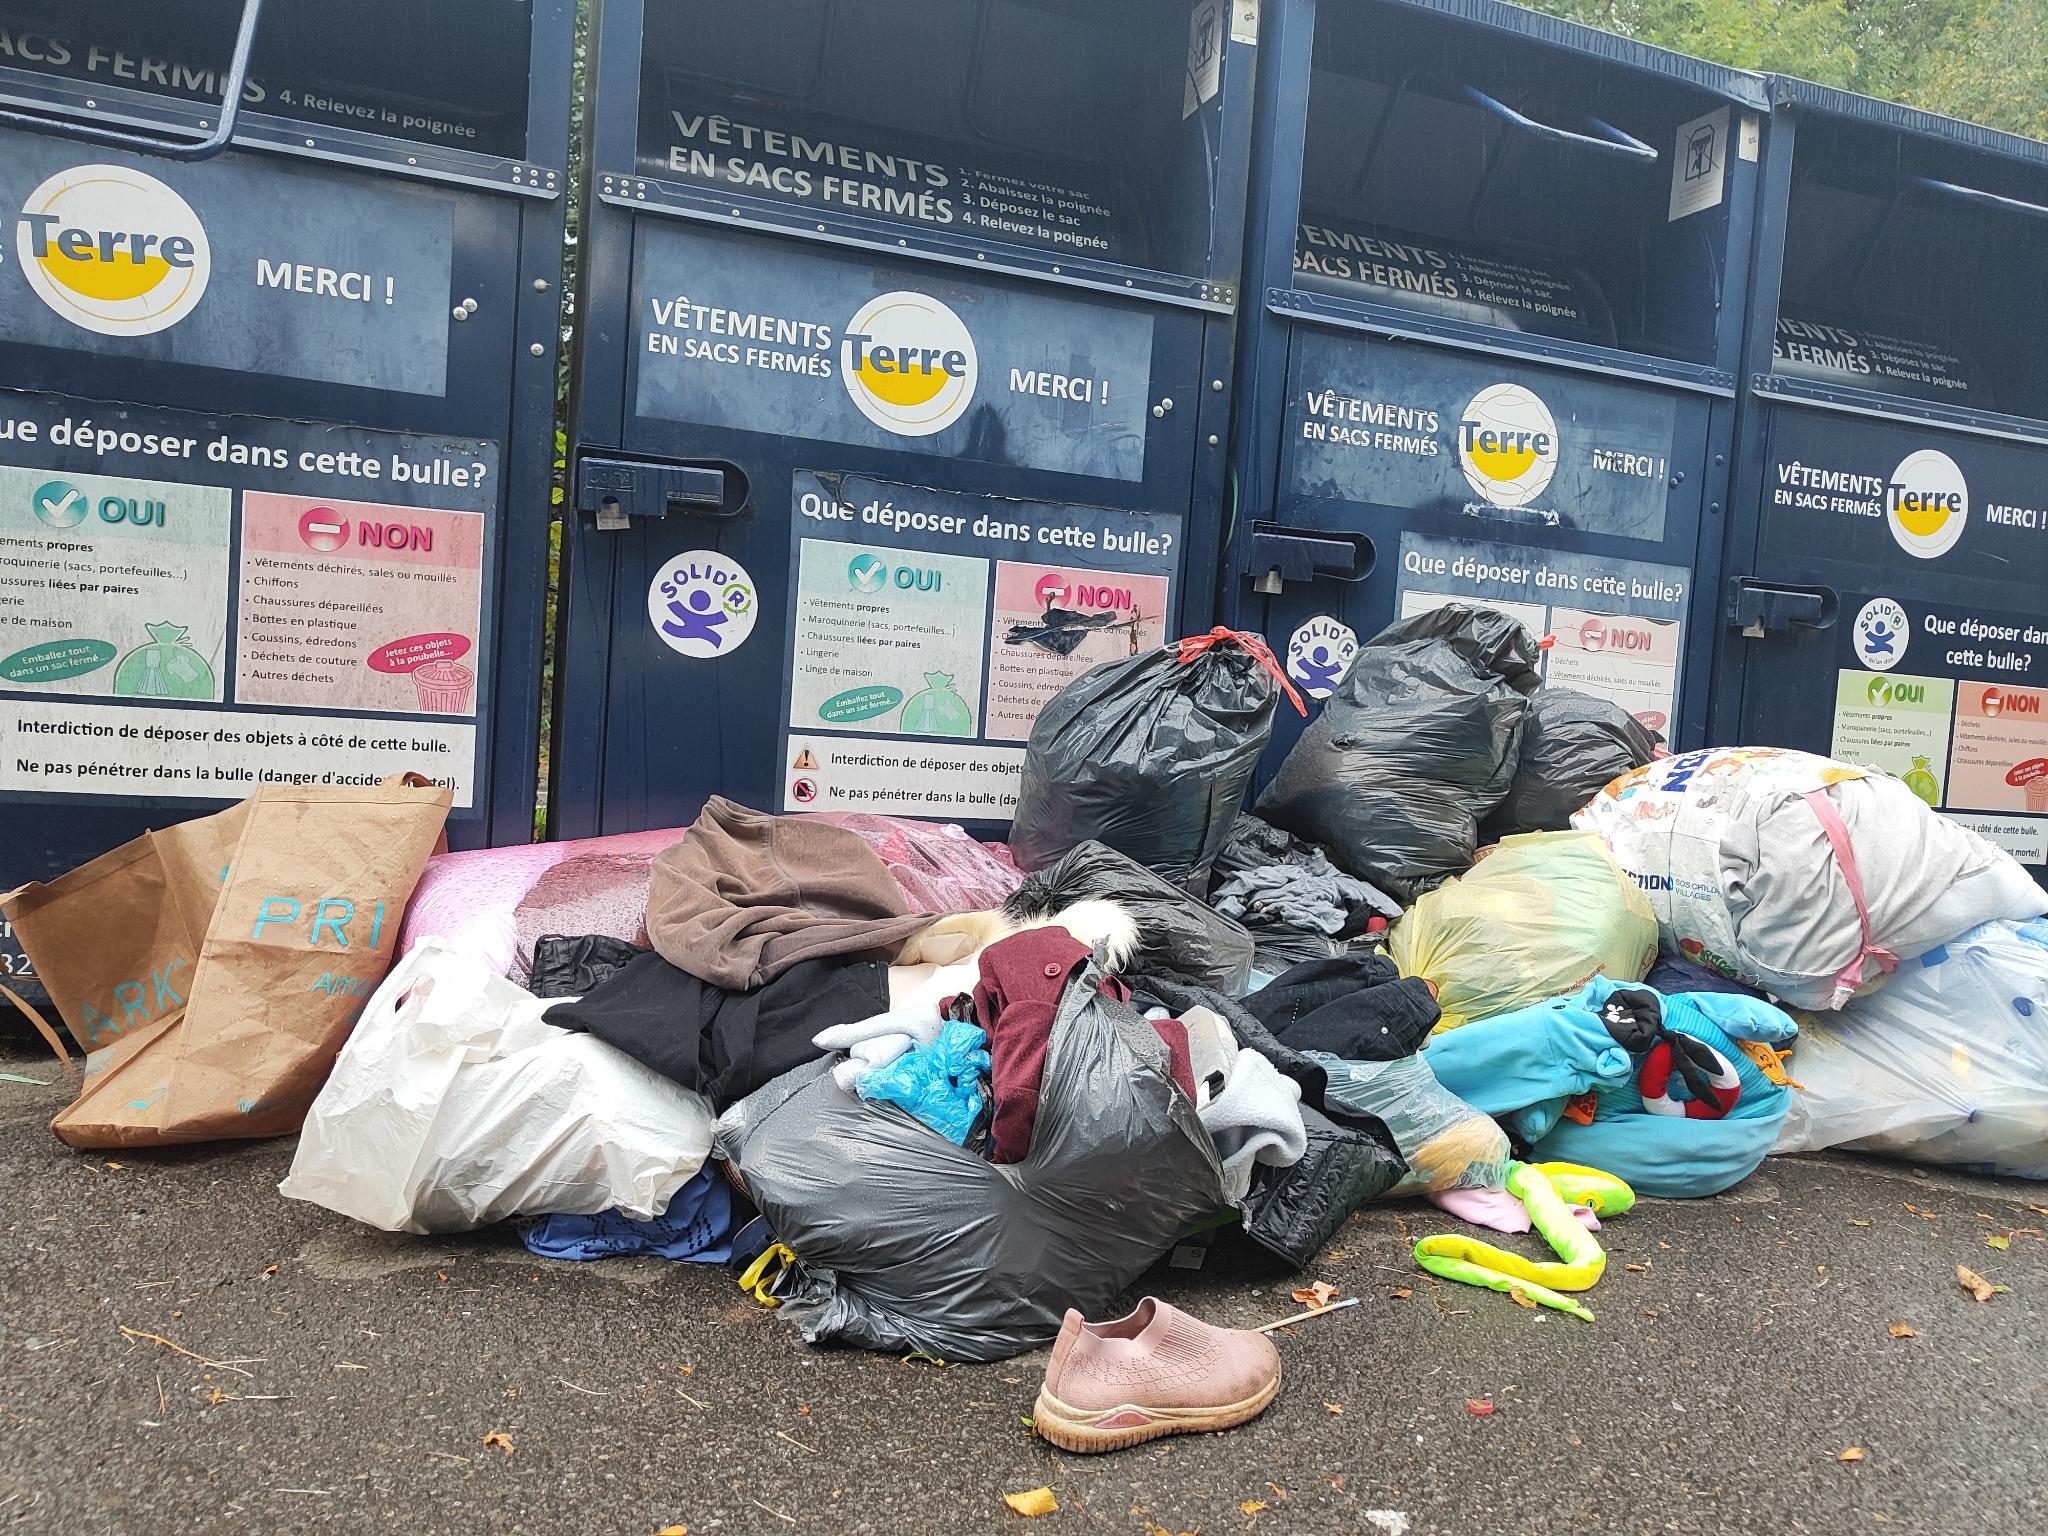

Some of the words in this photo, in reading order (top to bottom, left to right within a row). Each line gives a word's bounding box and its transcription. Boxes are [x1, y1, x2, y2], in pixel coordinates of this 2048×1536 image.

[0, 31, 71, 65] ACS
[280, 89, 297, 105] 4.
[304, 94, 375, 119] Relevez
[381, 107, 396, 123] la
[403, 114, 476, 137] poignée
[671, 110, 949, 187] VÊTEMENTS
[670, 145, 715, 178] EN
[727, 158, 813, 197] SACS
[823, 175, 954, 224] FERMÉS
[961, 178, 974, 189] 2.
[978, 181, 1038, 202] Abaissez
[1042, 194, 1054, 205] la
[1058, 199, 1111, 217] poignée
[962, 193, 976, 206] 3.
[980, 196, 1039, 218] Déposez
[1043, 208, 1055, 221] le
[1059, 213, 1081, 226] sac
[20, 213, 194, 267] Terre
[962, 211, 976, 225] 4.
[980, 214, 1034, 236] Relevez
[1038, 224, 1050, 239] la
[1054, 230, 1109, 249] poignée
[1302, 224, 1447, 269] EMENTS
[257, 259, 371, 303] MERCI
[1359, 260, 1458, 298] FERMÉS
[1465, 288, 1476, 299] 4.
[1478, 290, 1520, 307] Relevez
[1522, 298, 1532, 309] la
[1535, 303, 1577, 318] poignée
[651, 296, 832, 351] VÊTEMENTS
[648, 332, 678, 356] EN
[684, 337, 740, 365] SACS
[746, 346, 832, 379] FERMÉS
[843, 333, 966, 377] Terre
[1787, 341, 1870, 374] FERMÉS
[1009, 367, 1092, 404] MERCI
[1875, 364, 1885, 375] 4.
[1886, 366, 1920, 381] Relevez
[1922, 372, 1931, 383] la
[1933, 376, 1968, 390] poignée
[1307, 389, 1439, 433] VÊTEMENTS
[0, 419, 38, 443] ue
[50, 418, 197, 458] déposer
[207, 436, 288, 468] dans
[299, 450, 381, 478] cette
[391, 454, 487, 488] bulle?
[1303, 422, 1325, 440] EN
[1329, 426, 1371, 447] SACS
[1375, 432, 1438, 457] FERMÉS
[1460, 421, 1550, 456] Terre
[1593, 448, 1653, 479] MERCI
[1778, 461, 1882, 497] VÊTEMENTS
[99, 496, 166, 527] OUI
[1774, 489, 1792, 505] EN
[1795, 492, 1828, 510] SACS
[1831, 499, 1882, 518] FERMÉS
[1887, 483, 1961, 513] Terre
[800, 493, 854, 521] Que
[862, 503, 966, 537] déposer
[973, 514, 1031, 543] dans
[1037, 525, 1096, 549] cette
[1103, 527, 1173, 556] bulle?
[1986, 504, 2036, 529] MERCI
[47, 541, 94, 554] propres
[358, 521, 433, 552] NON
[64, 561, 96, 574] (sacs,
[255, 557, 314, 571] Vêtements
[317, 562, 365, 577] déchirés,
[369, 567, 394, 579] sales
[398, 571, 411, 580] ou
[414, 572, 457, 584] mouillés
[894, 566, 942, 592] OUI
[1404, 551, 1446, 576] Que
[1452, 557, 1530, 585] déposer
[1535, 566, 1578, 590] dans
[1583, 576, 1626, 597] cette
[1631, 578, 1683, 603] bulle?
[49, 579, 76, 590] liées
[80, 582, 99, 593] par
[103, 584, 139, 595] paires
[254, 577, 299, 589] Chiffons
[1077, 584, 1131, 610] NON
[253, 595, 315, 609] Chaussures
[319, 600, 384, 614] dépareillées
[809, 598, 855, 611] Vêtements
[856, 604, 890, 614] propres
[11, 615, 26, 625] de
[30, 618, 73, 629] maison
[252, 614, 288, 625] Bottes
[291, 617, 304, 626] en
[308, 617, 357, 631] plastique
[1924, 614, 1956, 635] Que
[1960, 618, 2020, 642] déposer
[251, 632, 303, 646] Coussins,
[306, 635, 357, 648] édredons
[1611, 628, 1652, 651] NON
[251, 651, 295, 663] Déchets
[299, 653, 313, 663] de
[315, 656, 357, 667] couture
[1946, 649, 1982, 667] cette
[1987, 650, 2032, 672] bulle?
[252, 670, 288, 681] Autres
[291, 671, 334, 683] déchets
[1895, 683, 1924, 703] OUI
[2006, 694, 2040, 713] NON
[17, 719, 114, 737] Interdiction
[119, 724, 139, 739] de
[144, 725, 209, 742] déposer
[214, 729, 241, 743] des
[245, 730, 293, 747] objets
[298, 732, 307, 746] à
[311, 733, 344, 748] côté
[348, 735, 367, 749] de
[371, 737, 407, 750] cette
[412, 738, 451, 753] bulle.
[16, 758, 39, 773] Ne
[44, 761, 73, 776] pas
[77, 760, 149, 778] pénétrer
[153, 764, 191, 779] dans
[196, 766, 209, 780] la
[215, 767, 253, 782] bulle
[258, 768, 318, 786] (danger
[831, 752, 899, 768] Interdiction
[902, 757, 917, 769] de
[920, 758, 966, 774] déposer
[969, 760, 988, 772] des
[829, 786, 845, 798] Ne
[849, 789, 869, 801] pas
[873, 788, 923, 803] pénétrer
[926, 791, 953, 803] dans
[955, 791, 965, 803] la
[969, 792, 996, 805] bulle
[1675, 888, 1711, 901] VILLAGES
[1676, 879, 1690, 889] SOS
